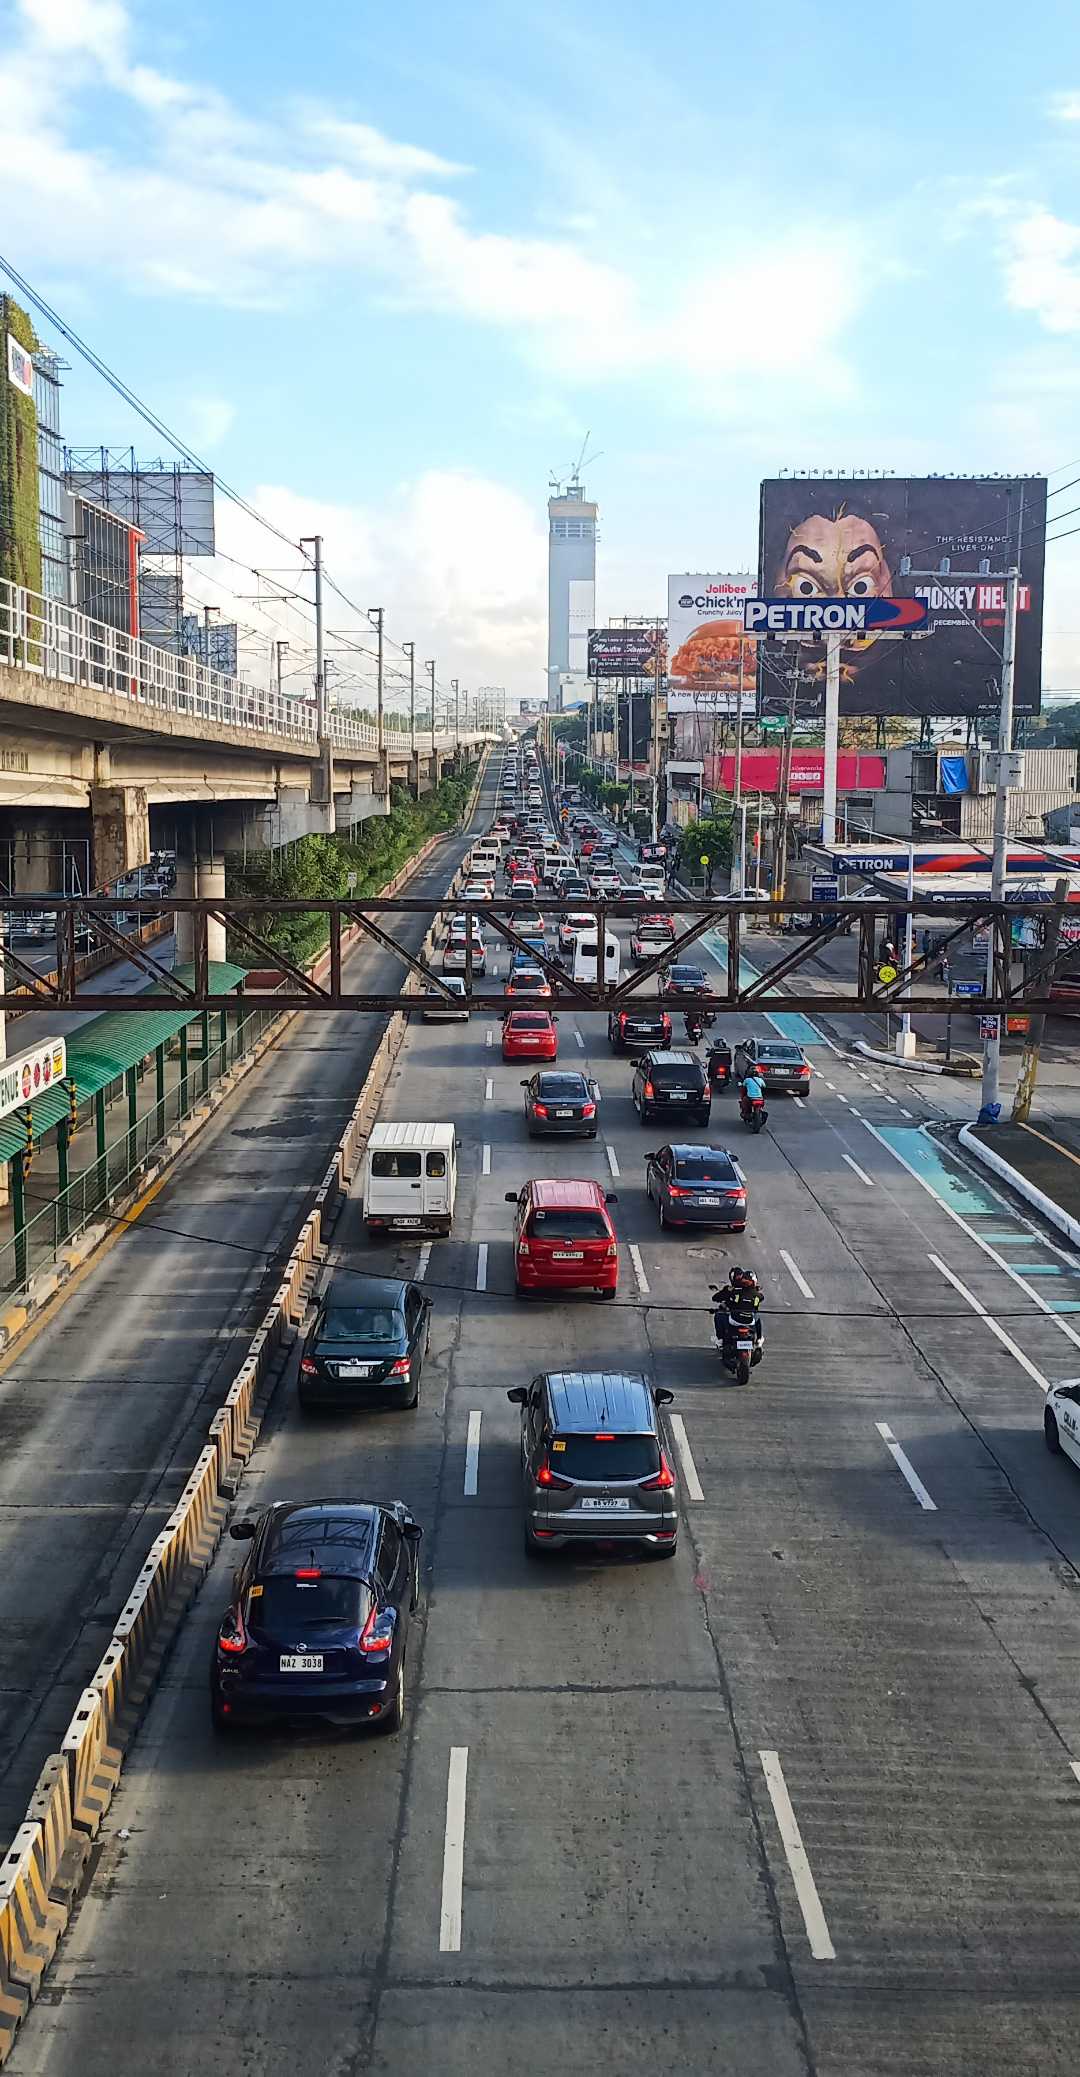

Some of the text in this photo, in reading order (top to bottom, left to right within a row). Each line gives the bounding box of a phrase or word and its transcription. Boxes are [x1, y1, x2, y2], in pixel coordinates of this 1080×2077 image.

[706, 584, 747, 593] Jollibee
[695, 596, 744, 608] Chick'n
[915, 586, 1029, 609] MONEY HEIT
[745, 602, 865, 629] PETRON
[281, 1658, 322, 1668] NAZ 3038
